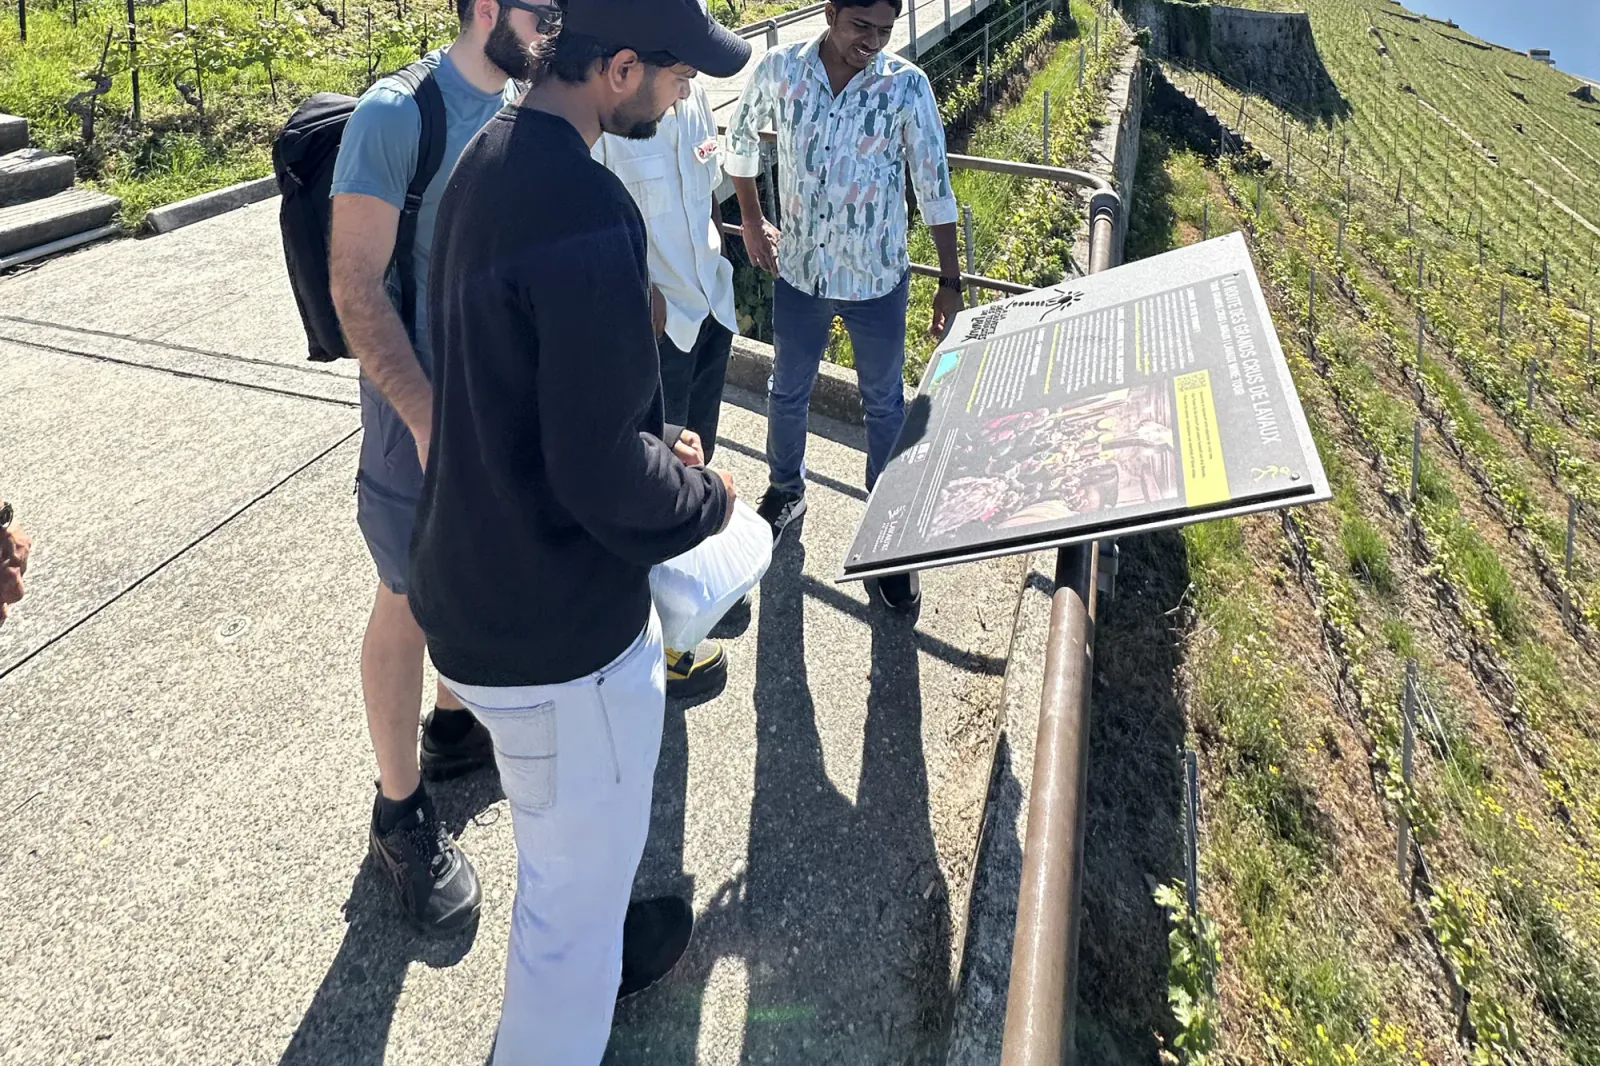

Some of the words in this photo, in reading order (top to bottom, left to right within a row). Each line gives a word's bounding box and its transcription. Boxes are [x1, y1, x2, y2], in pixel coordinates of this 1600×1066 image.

[1220, 276, 1235, 287] LA
[1222, 285, 1242, 308] ROUTE
[1228, 307, 1246, 324] DES
[961, 316, 986, 342] LAVAUX
[1232, 322, 1256, 358] GRANDS
[1223, 342, 1237, 363] LAVAUX
[1231, 378, 1244, 396] TOUR
[1241, 357, 1264, 385] CRUS
[1248, 384, 1268, 400] DE
[1252, 400, 1281, 444] LAVAUX
